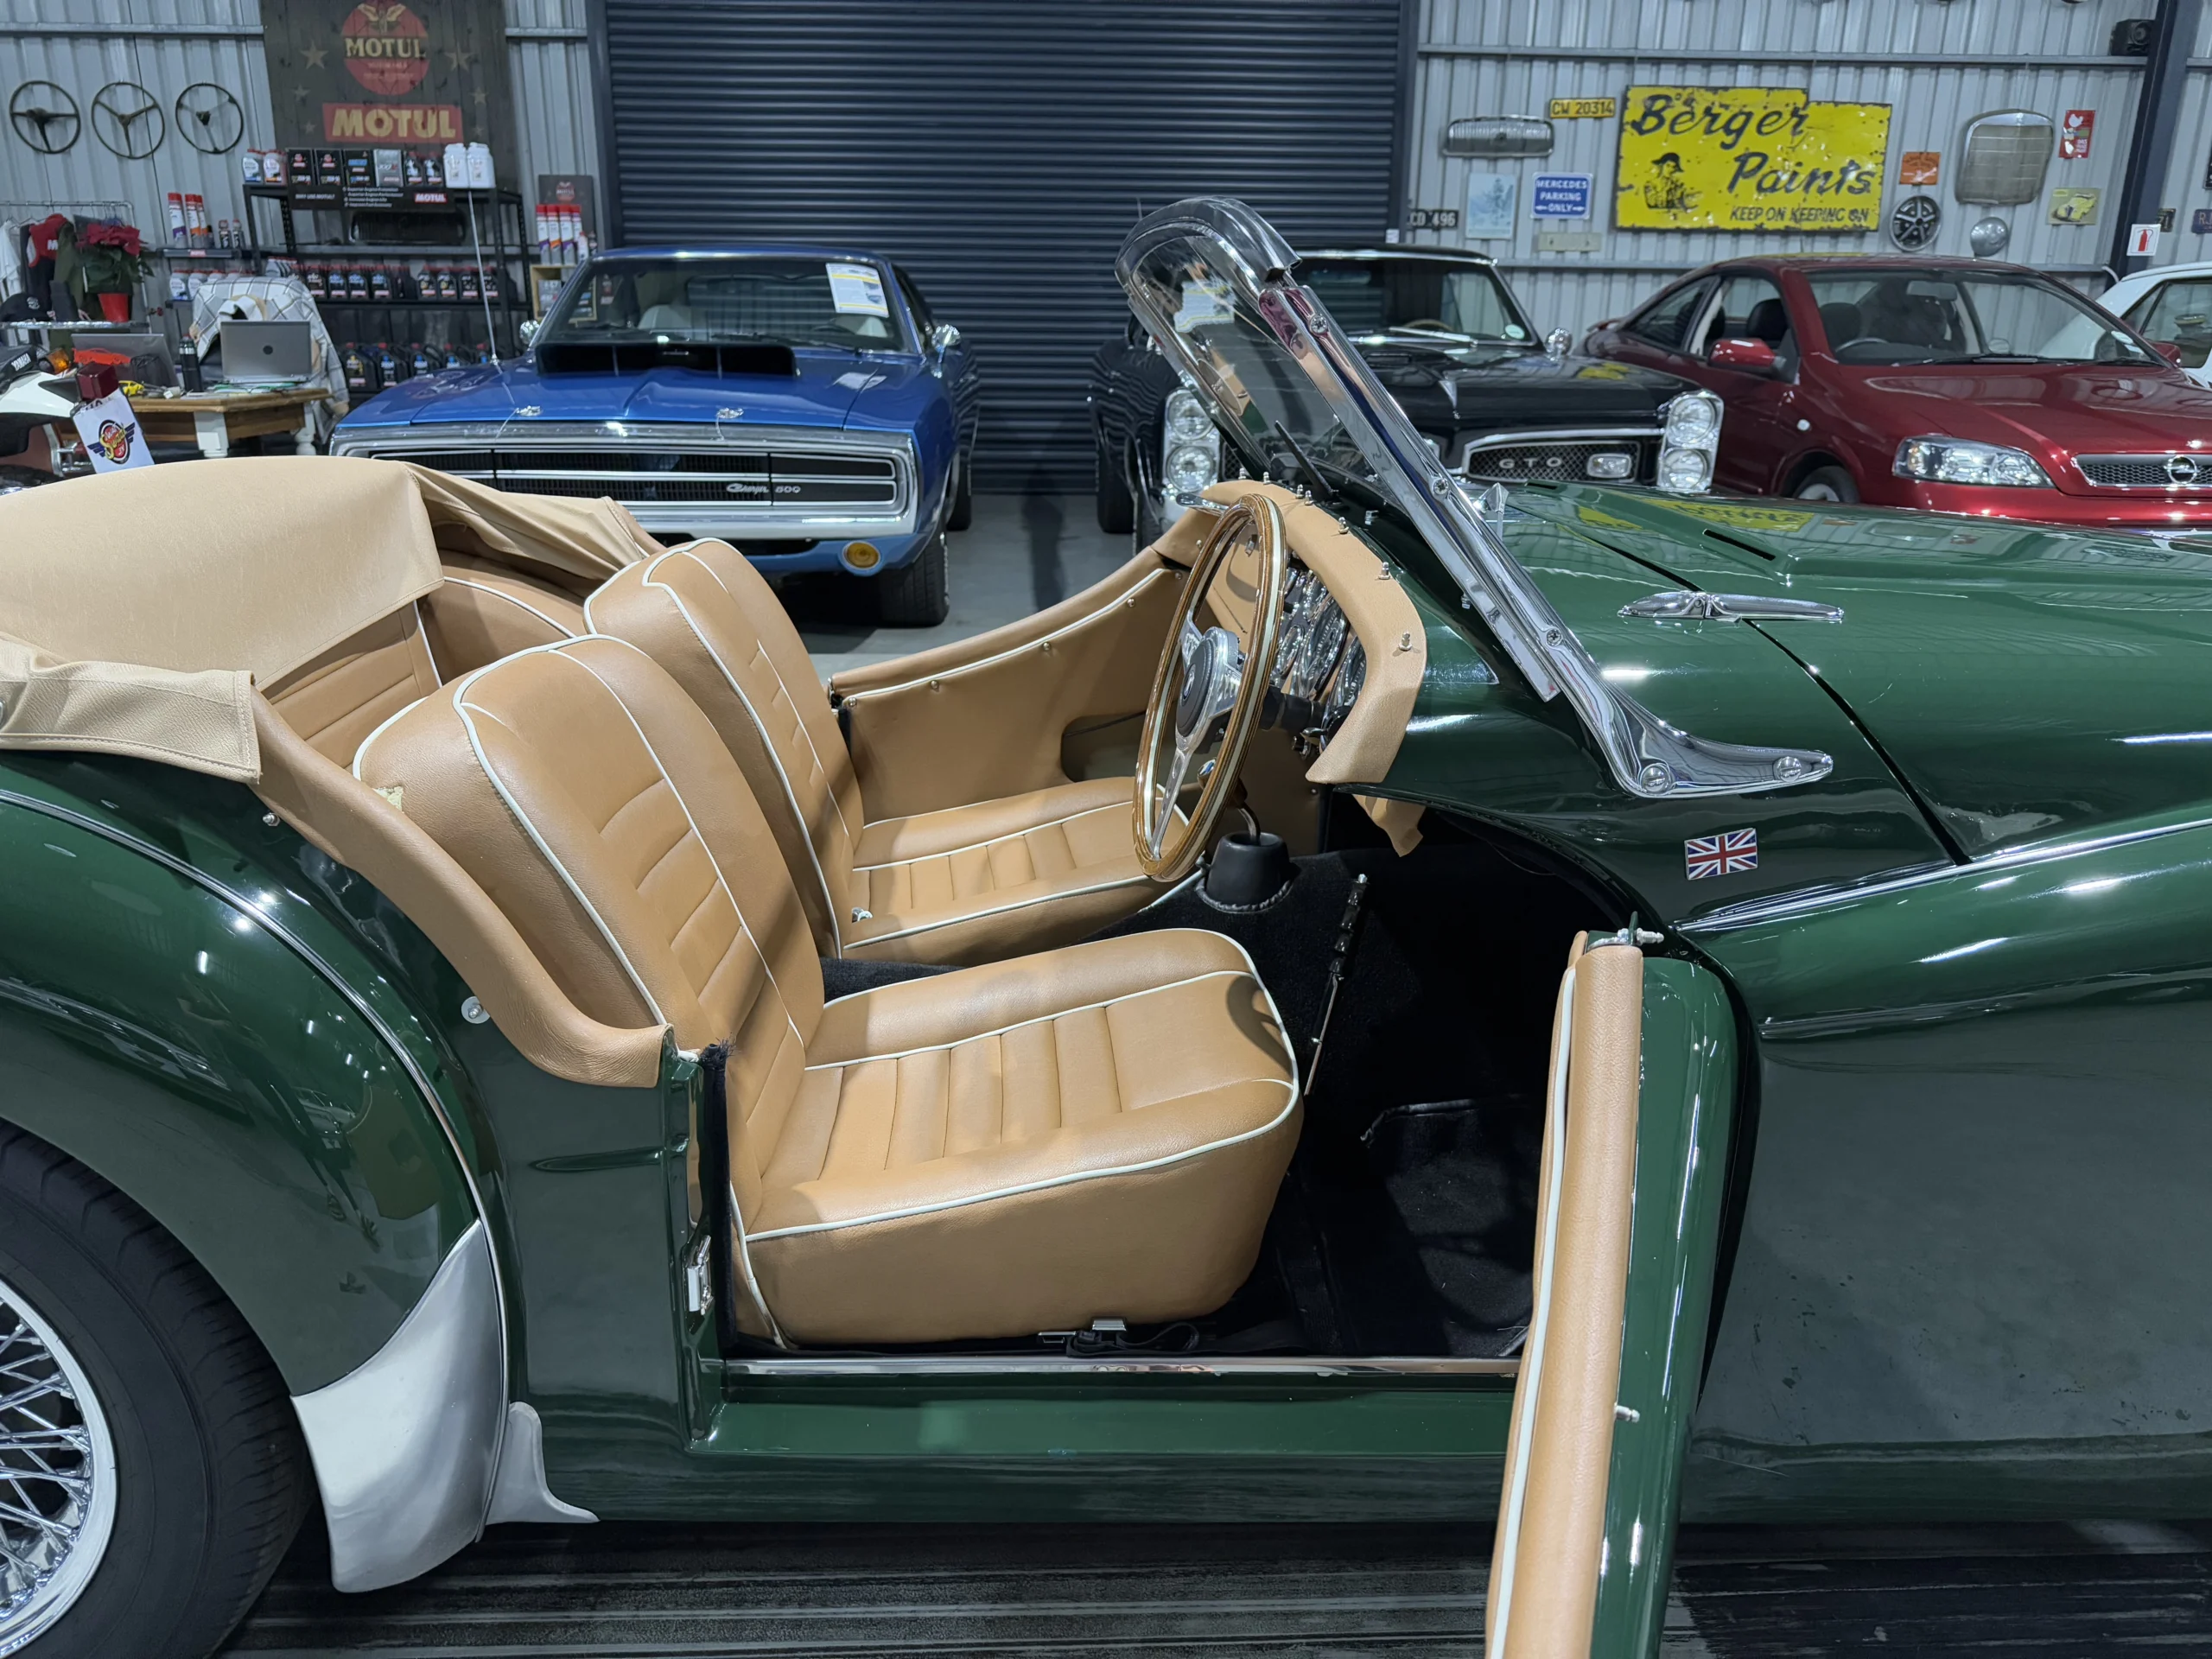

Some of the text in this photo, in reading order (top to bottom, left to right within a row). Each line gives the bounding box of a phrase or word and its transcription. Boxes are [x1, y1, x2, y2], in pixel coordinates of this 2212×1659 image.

[345, 37, 426, 59] MOTUL
[332, 108, 456, 139] MOTUL
[1630, 89, 1808, 149] Berger
[1727, 151, 1876, 195] Paints
[1536, 180, 1588, 189] MERCEDES
[1540, 192, 1581, 201] PARKING
[1548, 203, 1573, 213] ONLY
[1730, 207, 1764, 221] KEEP
[1766, 207, 1787, 221] ON
[1848, 208, 1870, 222] ON
[11, 353, 32, 372] YAMAHA
[1499, 456, 1562, 469] GTO
